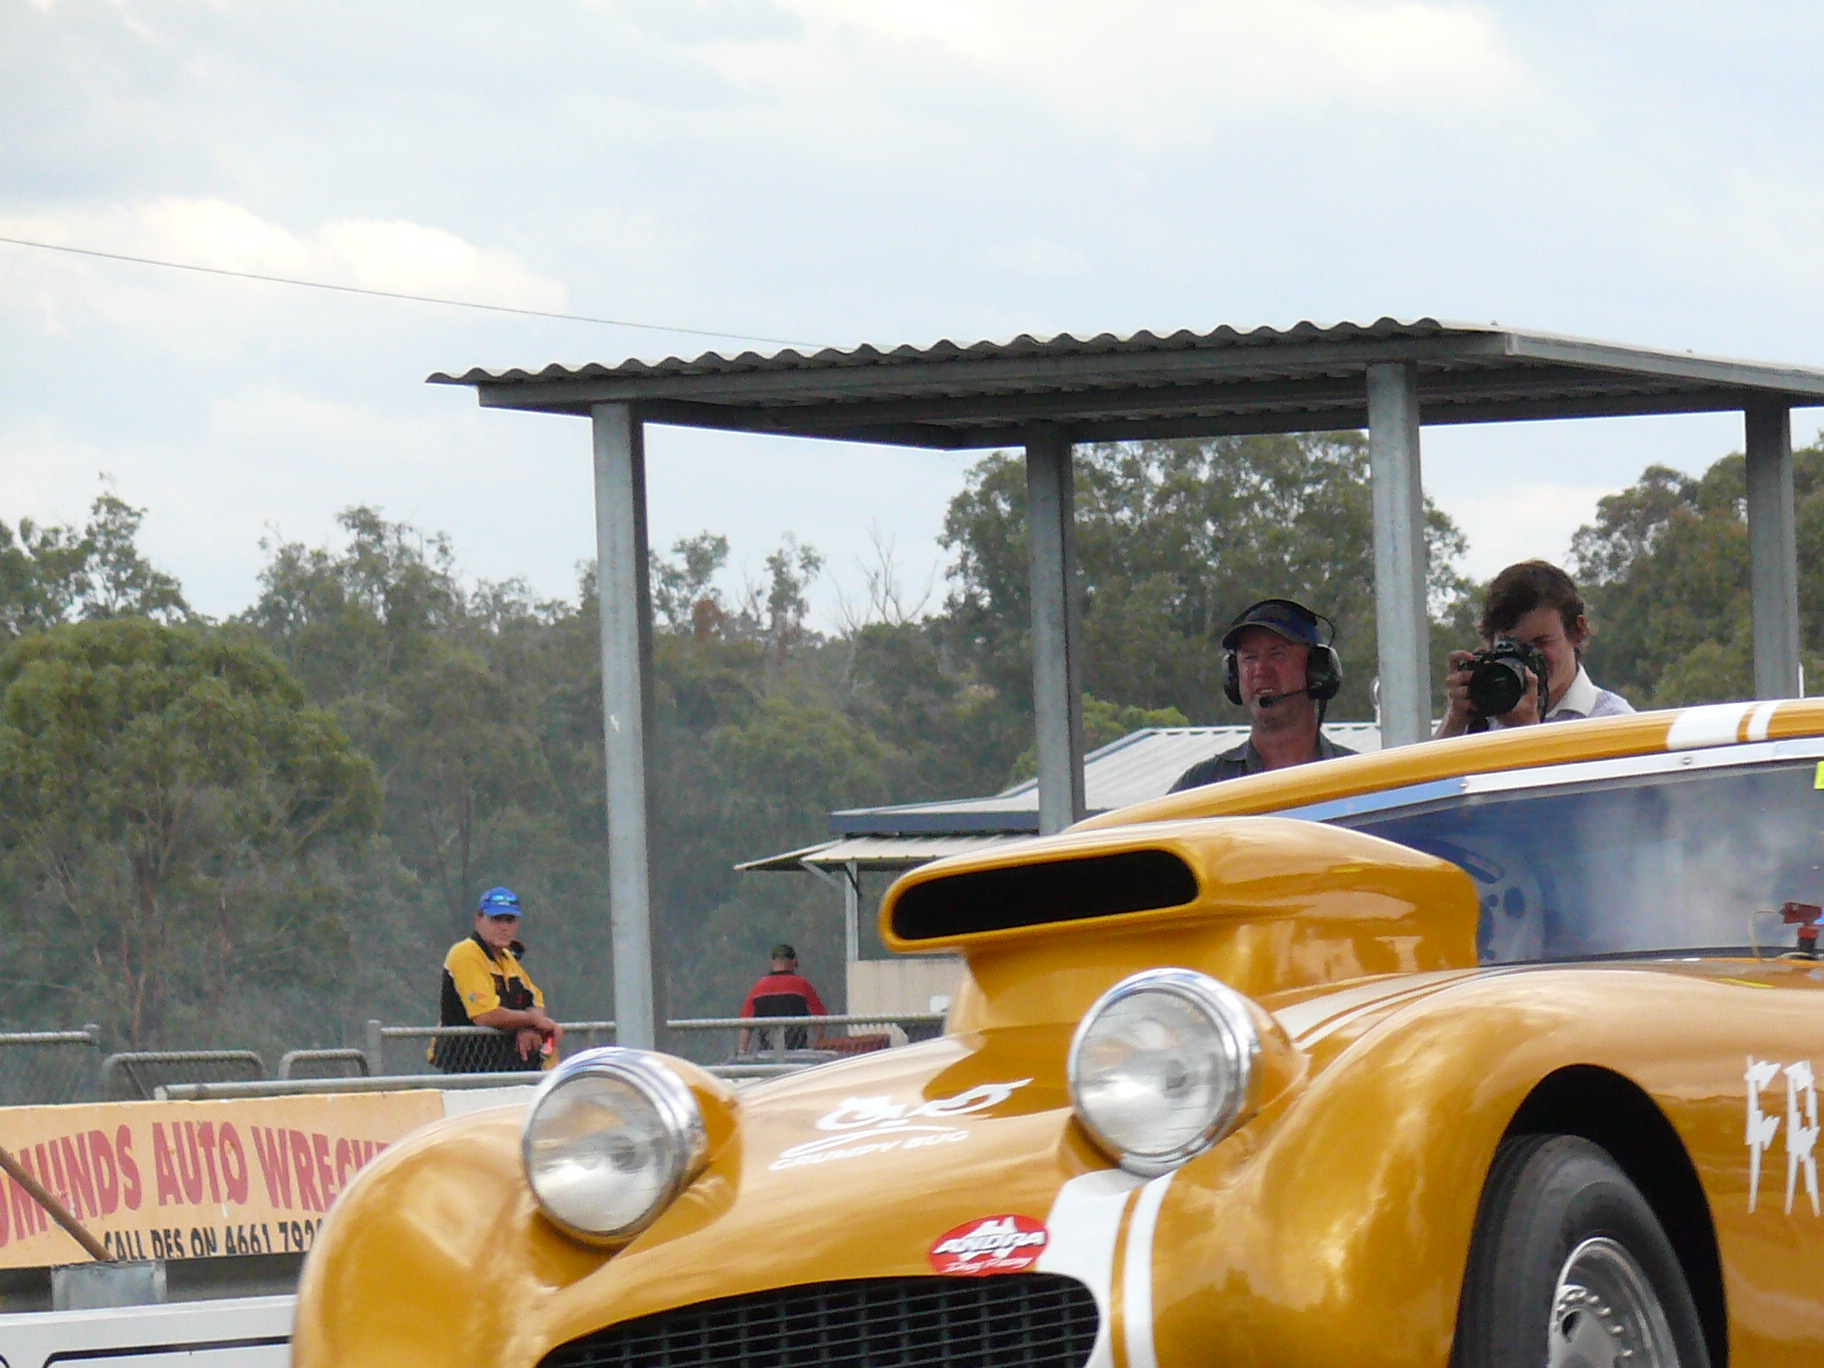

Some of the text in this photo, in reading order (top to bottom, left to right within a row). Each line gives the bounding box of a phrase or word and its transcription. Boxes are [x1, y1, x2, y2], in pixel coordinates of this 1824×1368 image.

[152, 1121, 249, 1206] AUTO
[251, 1125, 391, 1213] WREC
[104, 1218, 322, 1260] CALL DES ON 4661 792
